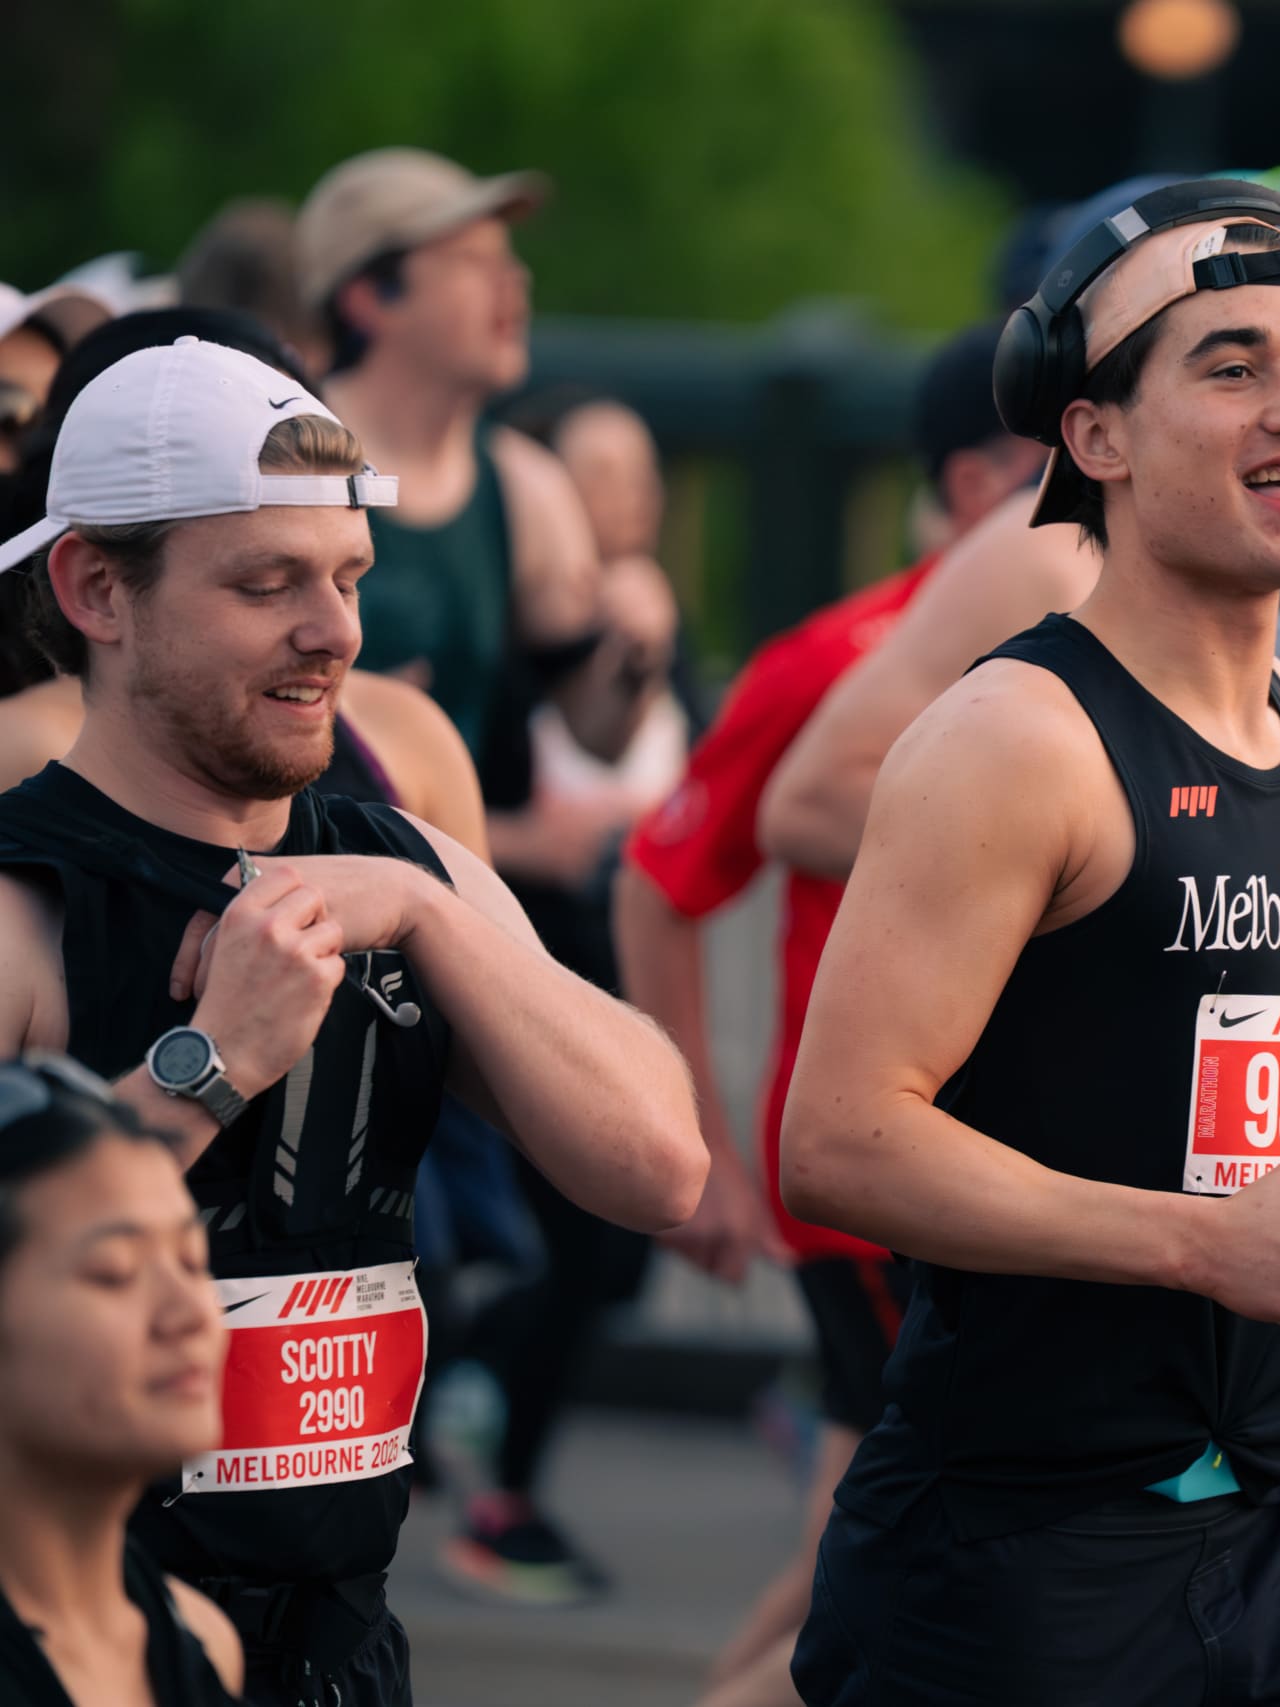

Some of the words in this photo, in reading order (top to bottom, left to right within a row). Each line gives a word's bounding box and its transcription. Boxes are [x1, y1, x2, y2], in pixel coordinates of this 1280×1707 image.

[1197, 1056, 1220, 1138] MARATHON
[280, 1331, 377, 1385] SCOTTY
[299, 1386, 365, 1435] 2990
[216, 1444, 364, 1485] MELBOURNE
[371, 1435, 400, 1470] 2025
